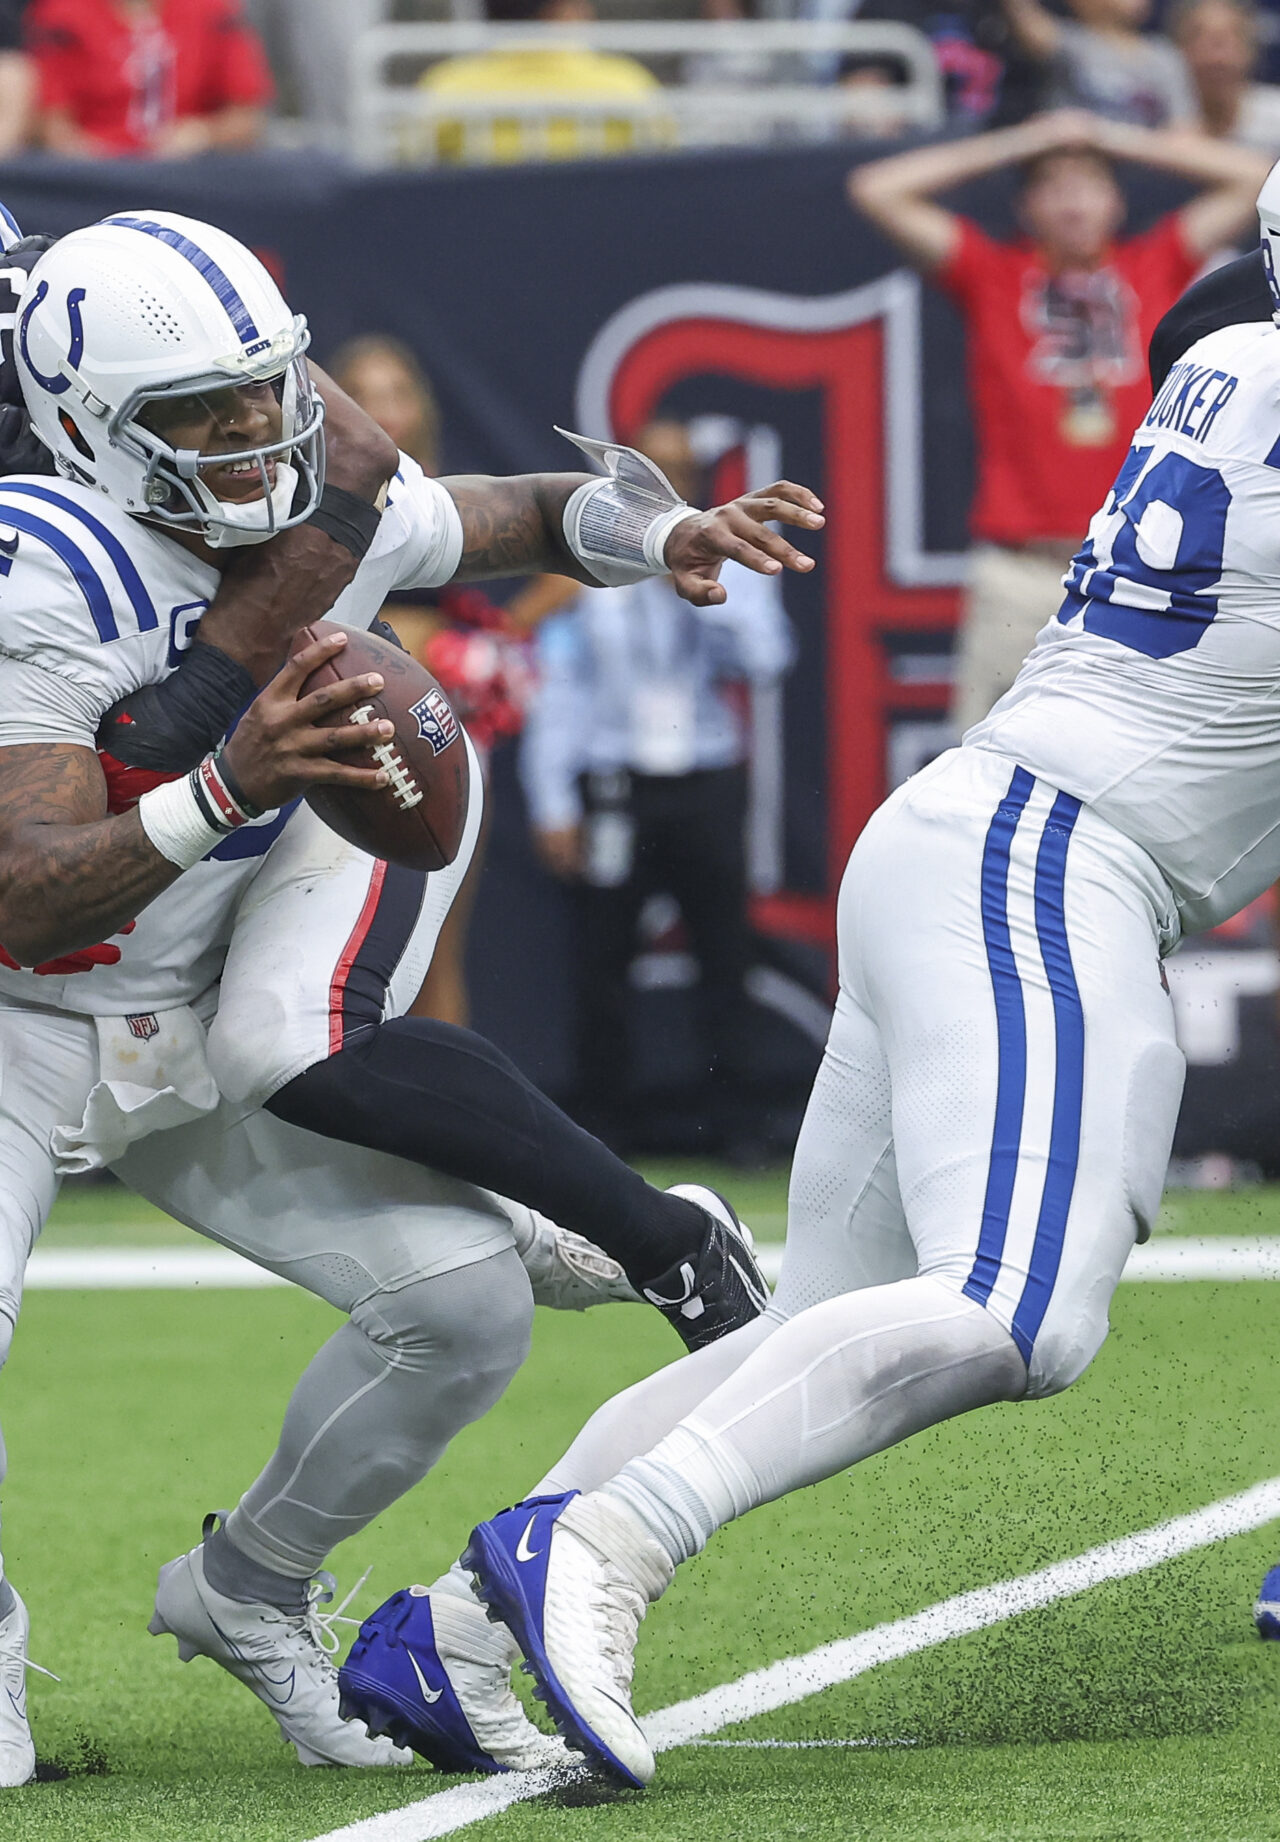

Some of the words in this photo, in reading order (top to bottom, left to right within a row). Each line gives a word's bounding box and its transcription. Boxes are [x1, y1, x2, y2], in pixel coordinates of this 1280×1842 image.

[1146, 363, 1239, 444] UCKER
[430, 694, 458, 738] NFL
[130, 1017, 157, 1037] NFL
